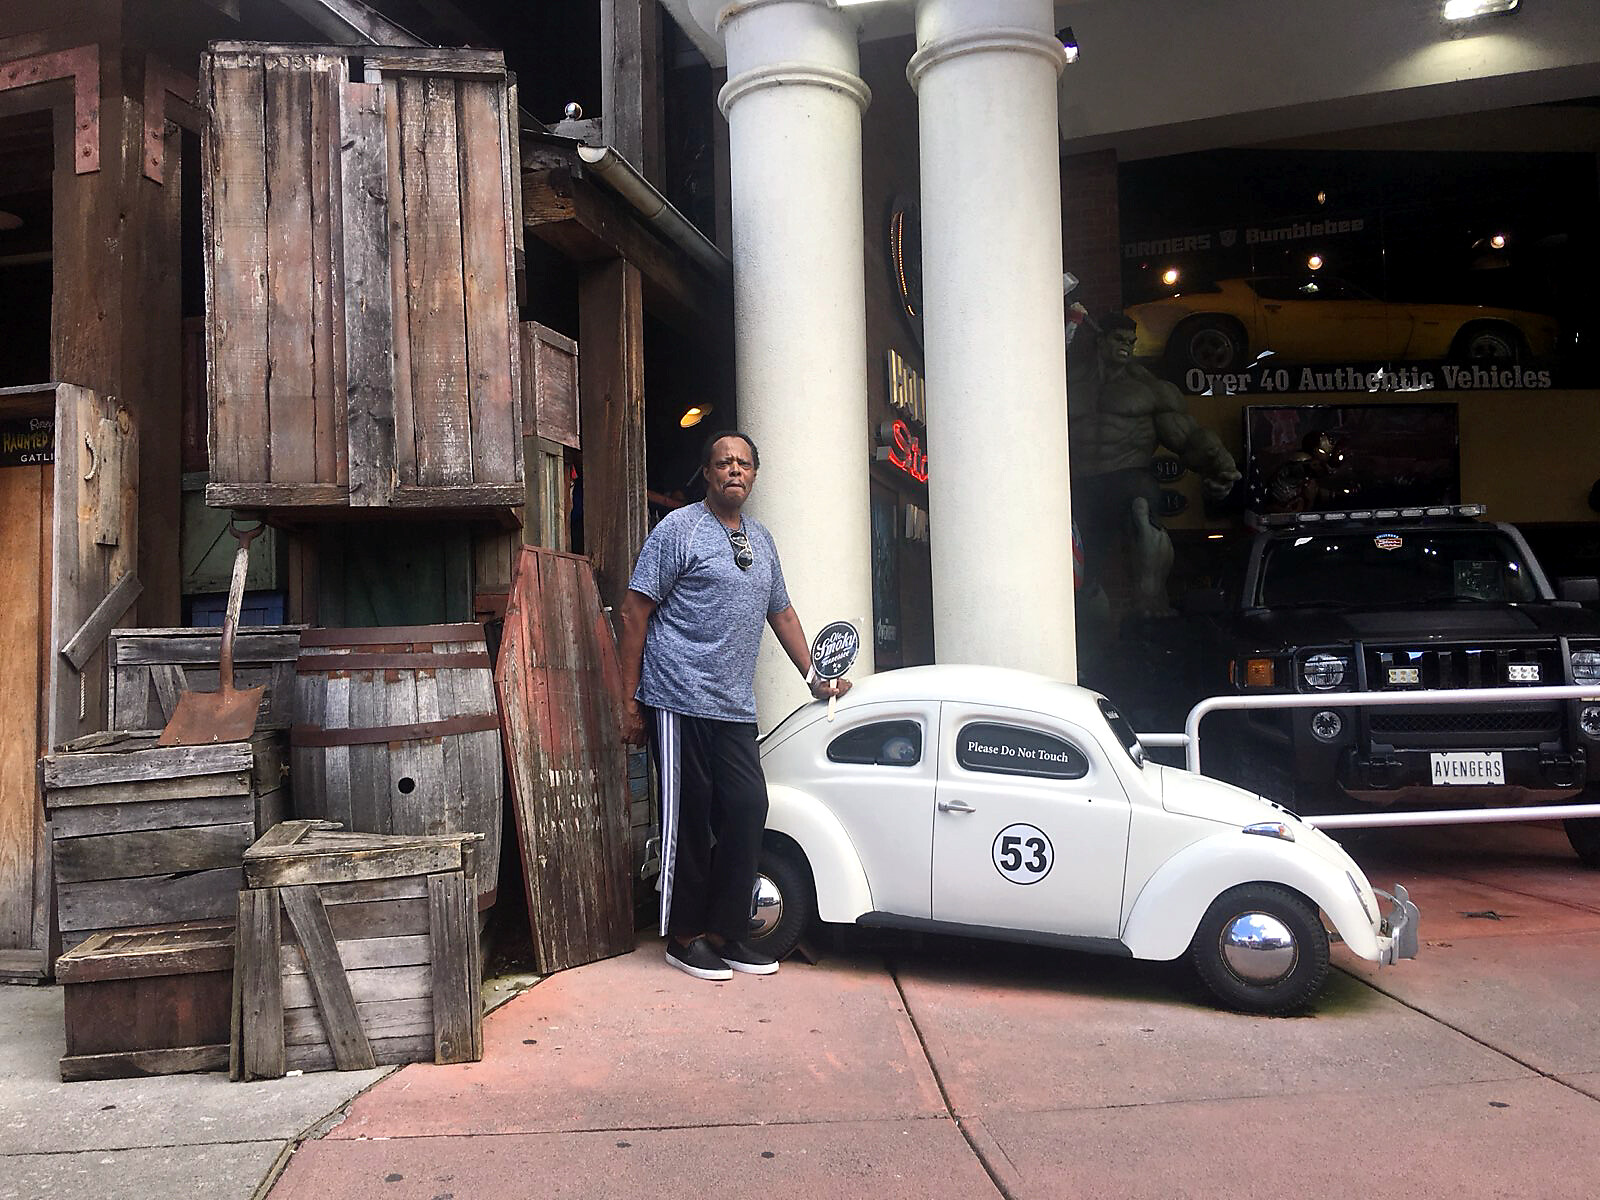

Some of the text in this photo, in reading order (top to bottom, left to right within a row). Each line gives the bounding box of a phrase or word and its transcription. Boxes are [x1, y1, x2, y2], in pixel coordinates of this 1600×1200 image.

[1246, 219, 1364, 245] Bumblebee
[1185, 365, 1552, 392] Over 40 Authentic Vehicles
[815, 632, 856, 660] Smoky
[968, 741, 1069, 762] Please Do Not Touch
[1435, 760, 1501, 777] AVENGERS
[1000, 836, 1047, 873] 53
